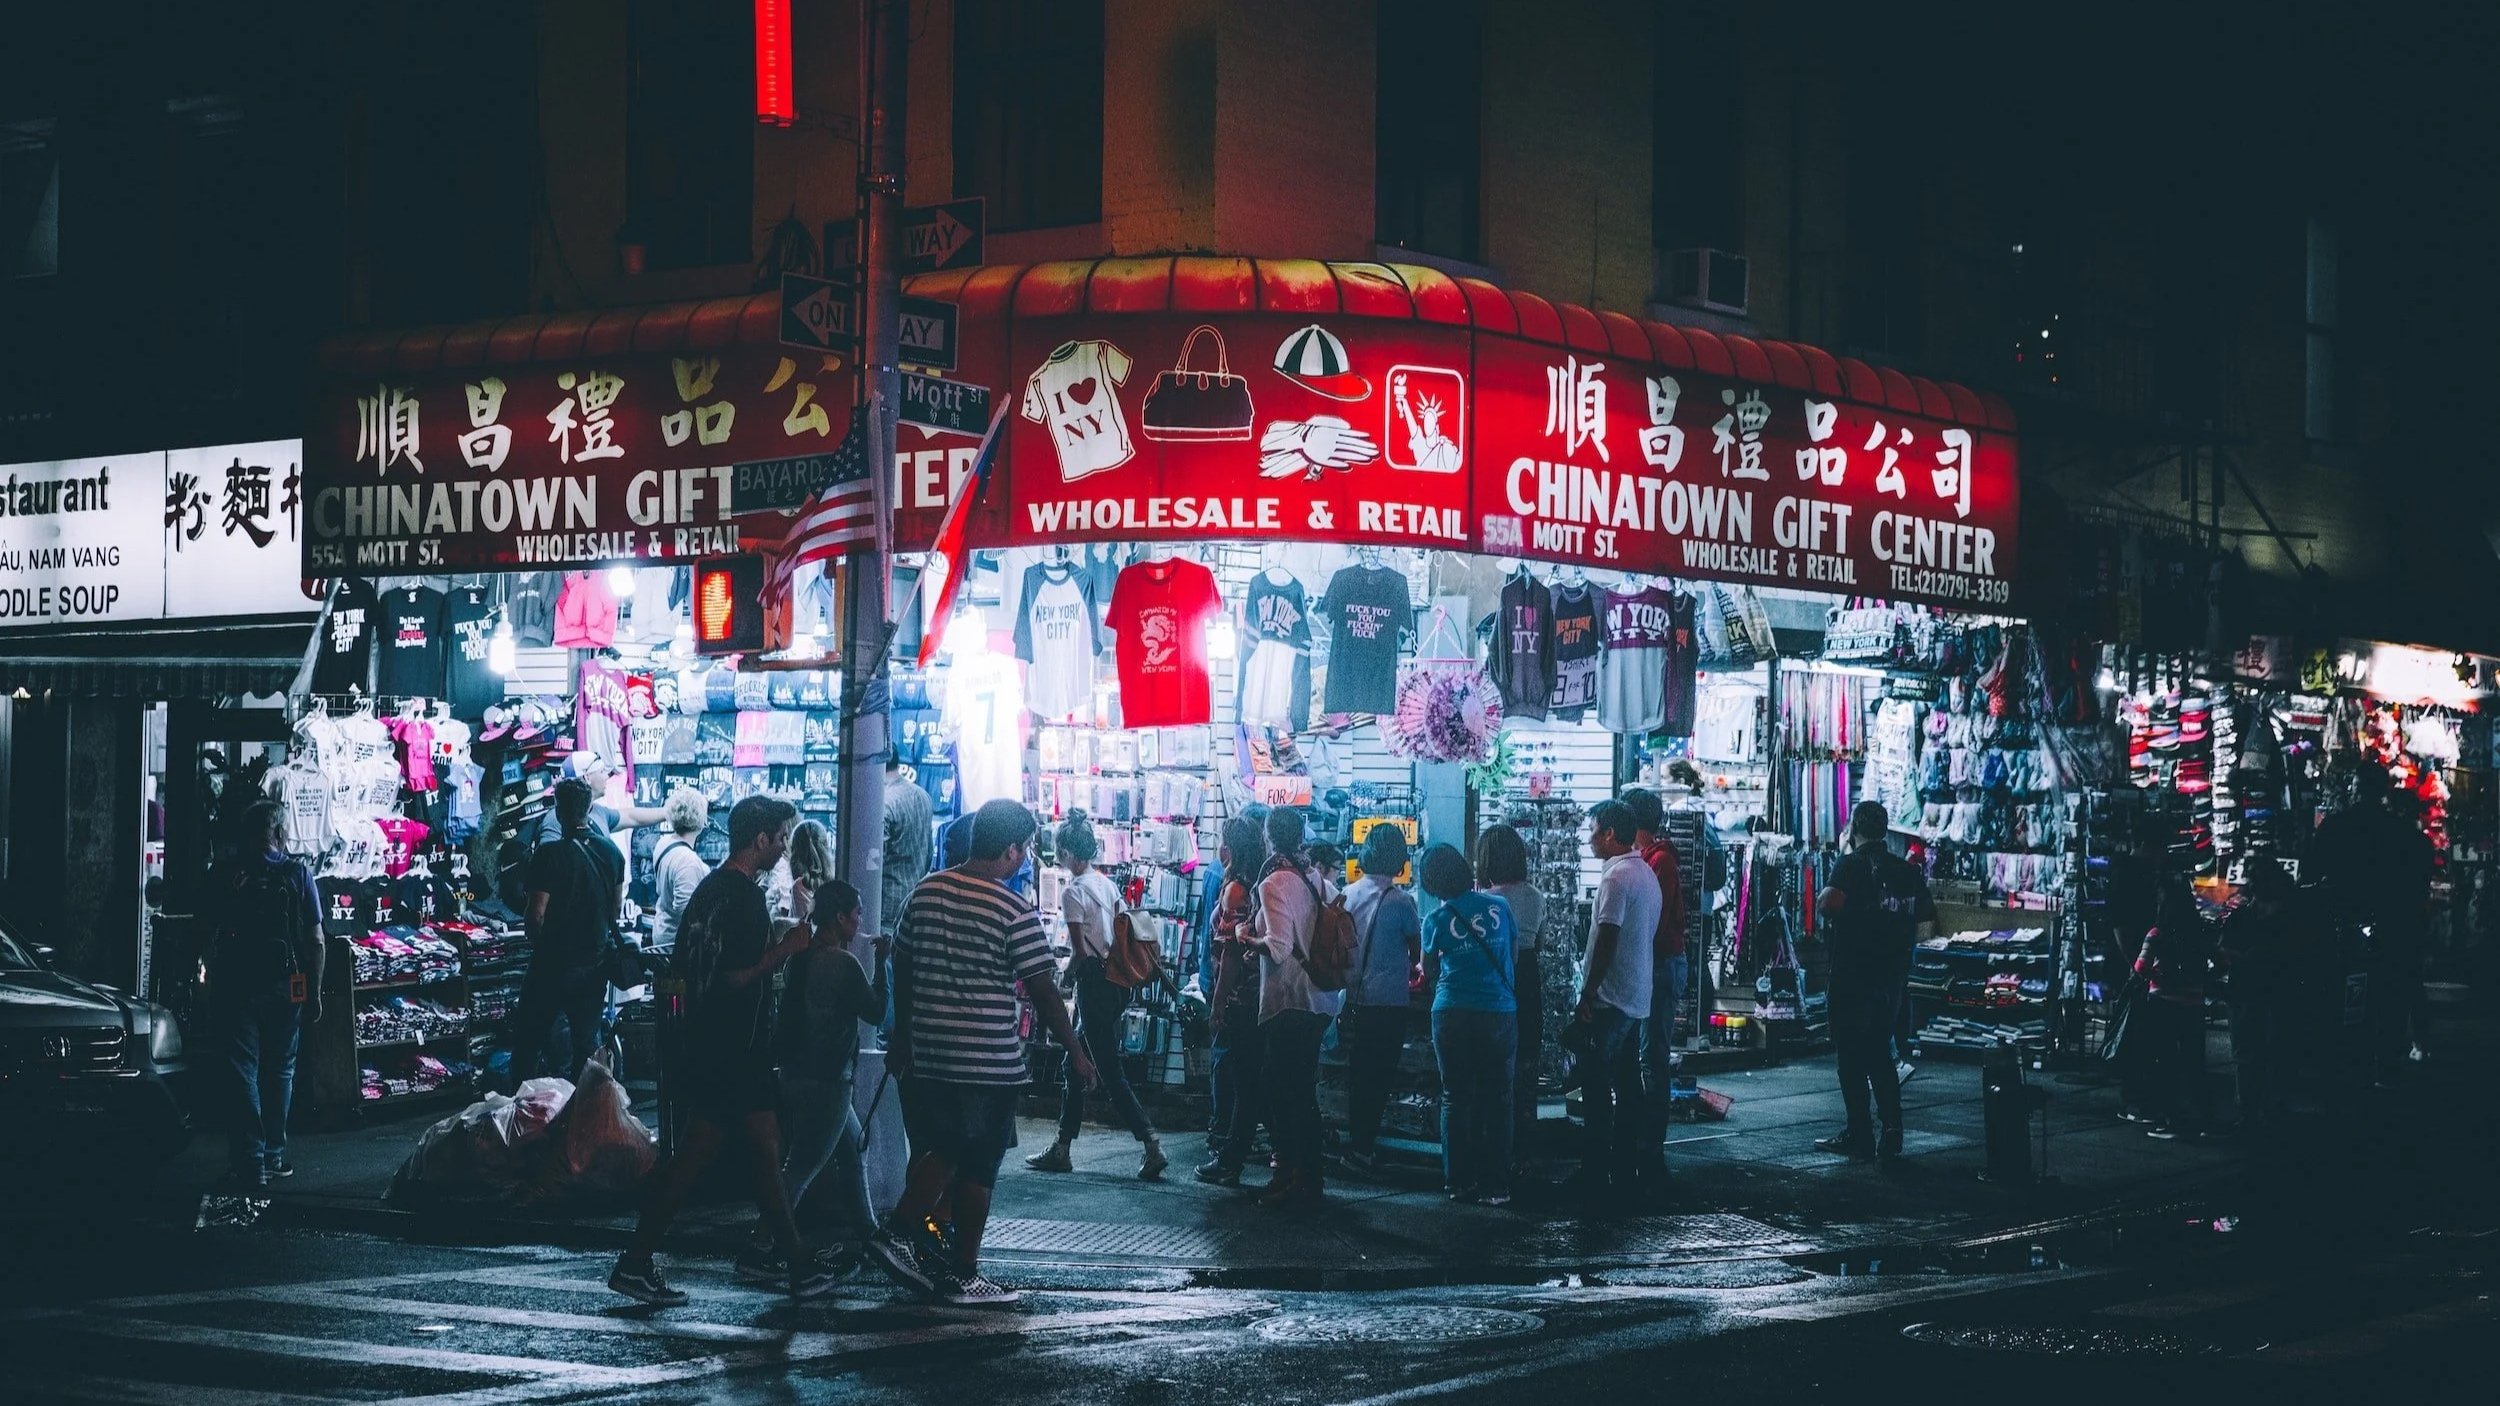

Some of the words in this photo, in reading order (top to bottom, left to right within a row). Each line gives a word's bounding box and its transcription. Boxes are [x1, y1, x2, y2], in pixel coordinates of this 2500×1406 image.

[909, 221, 958, 255] WAY
[808, 301, 841, 330] ON
[900, 317, 936, 345] AY
[906, 375, 963, 412] Mott
[1054, 391, 1066, 416] I
[356, 355, 842, 476] 順昌禮品公
[1063, 409, 1103, 446] NY
[1545, 355, 1972, 518] 順昌禮品公司
[739, 459, 822, 491] BAYARD
[313, 474, 597, 539] CHINATOWN
[626, 465, 734, 527] GIFT
[1028, 497, 1281, 534] WHOLESALE
[1307, 500, 1335, 530] &
[1358, 501, 1468, 542] RETAIL
[1505, 456, 1753, 544] CHINATOWN
[1773, 496, 1853, 556] GIFT
[1870, 510, 1996, 576] CENTER
[515, 530, 636, 563] WHOLESALE
[648, 531, 662, 558] &
[1483, 515, 1523, 548] 55A
[1532, 519, 1585, 555] MOTT
[1593, 529, 1619, 560] ST.
[29, 548, 66, 571] NAM
[72, 546, 120, 568] VANG
[312, 543, 346, 568] 55A
[357, 540, 409, 567] MOTT
[417, 538, 445, 566] ST.
[1682, 538, 1778, 577] WHOLESALE
[1786, 554, 1798, 580] &
[1806, 551, 1857, 586] RETAIL
[1889, 564, 2011, 604] TEL:(212)791-3369
[58, 585, 119, 616] SOUP
[1036, 604, 1055, 623] NEW
[1058, 601, 1080, 623] YORK
[1345, 604, 1369, 614] FUCK
[1372, 607, 1391, 617] YOU
[1358, 613, 1375, 622] YOU
[1515, 606, 1523, 629] I
[1556, 618, 1571, 636] NEW
[1572, 615, 1592, 632] YORK
[1047, 621, 1071, 640] CITY
[1352, 628, 1376, 639] FUCK
[1511, 631, 1539, 654] NY
[1562, 629, 1582, 645] CITY
[1830, 638, 1854, 649] NEW
[1854, 637, 1877, 649] YORK
[976, 690, 995, 745] 7
[638, 741, 658, 755] CITY
[1267, 789, 1286, 805] FOR
[429, 851, 446, 864] NY
[331, 907, 355, 920] NY
[332, 894, 340, 908] I
[377, 897, 383, 909] I
[375, 908, 393, 923] NY
